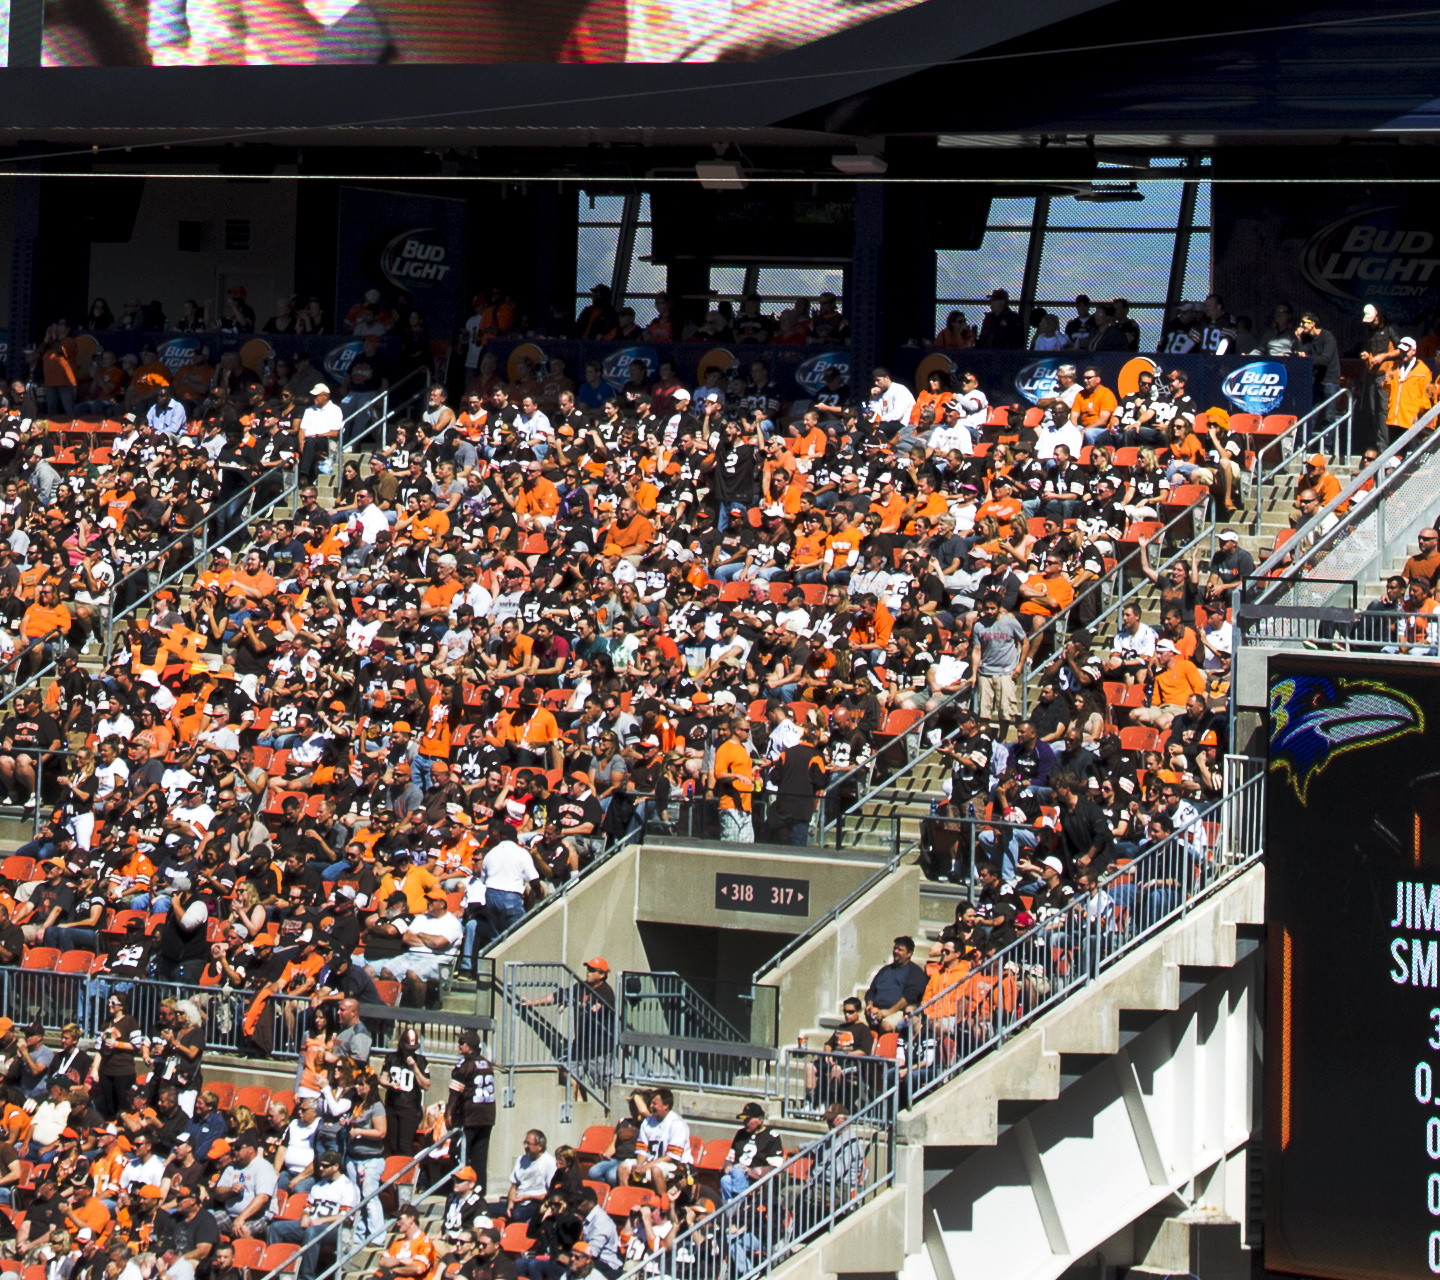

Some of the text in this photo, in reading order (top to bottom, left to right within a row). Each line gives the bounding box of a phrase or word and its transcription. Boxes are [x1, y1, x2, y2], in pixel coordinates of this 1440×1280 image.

[1337, 225, 1435, 253] BUD
[401, 239, 446, 262] BUD
[391, 257, 451, 281] LIGHT
[1364, 284, 1429, 297] BALCONY
[1240, 370, 1281, 385] BUD
[1231, 382, 1284, 397] LIGHT
[727, 452, 738, 473] 2
[731, 884, 754, 902] 318
[770, 886, 794, 905] 317
